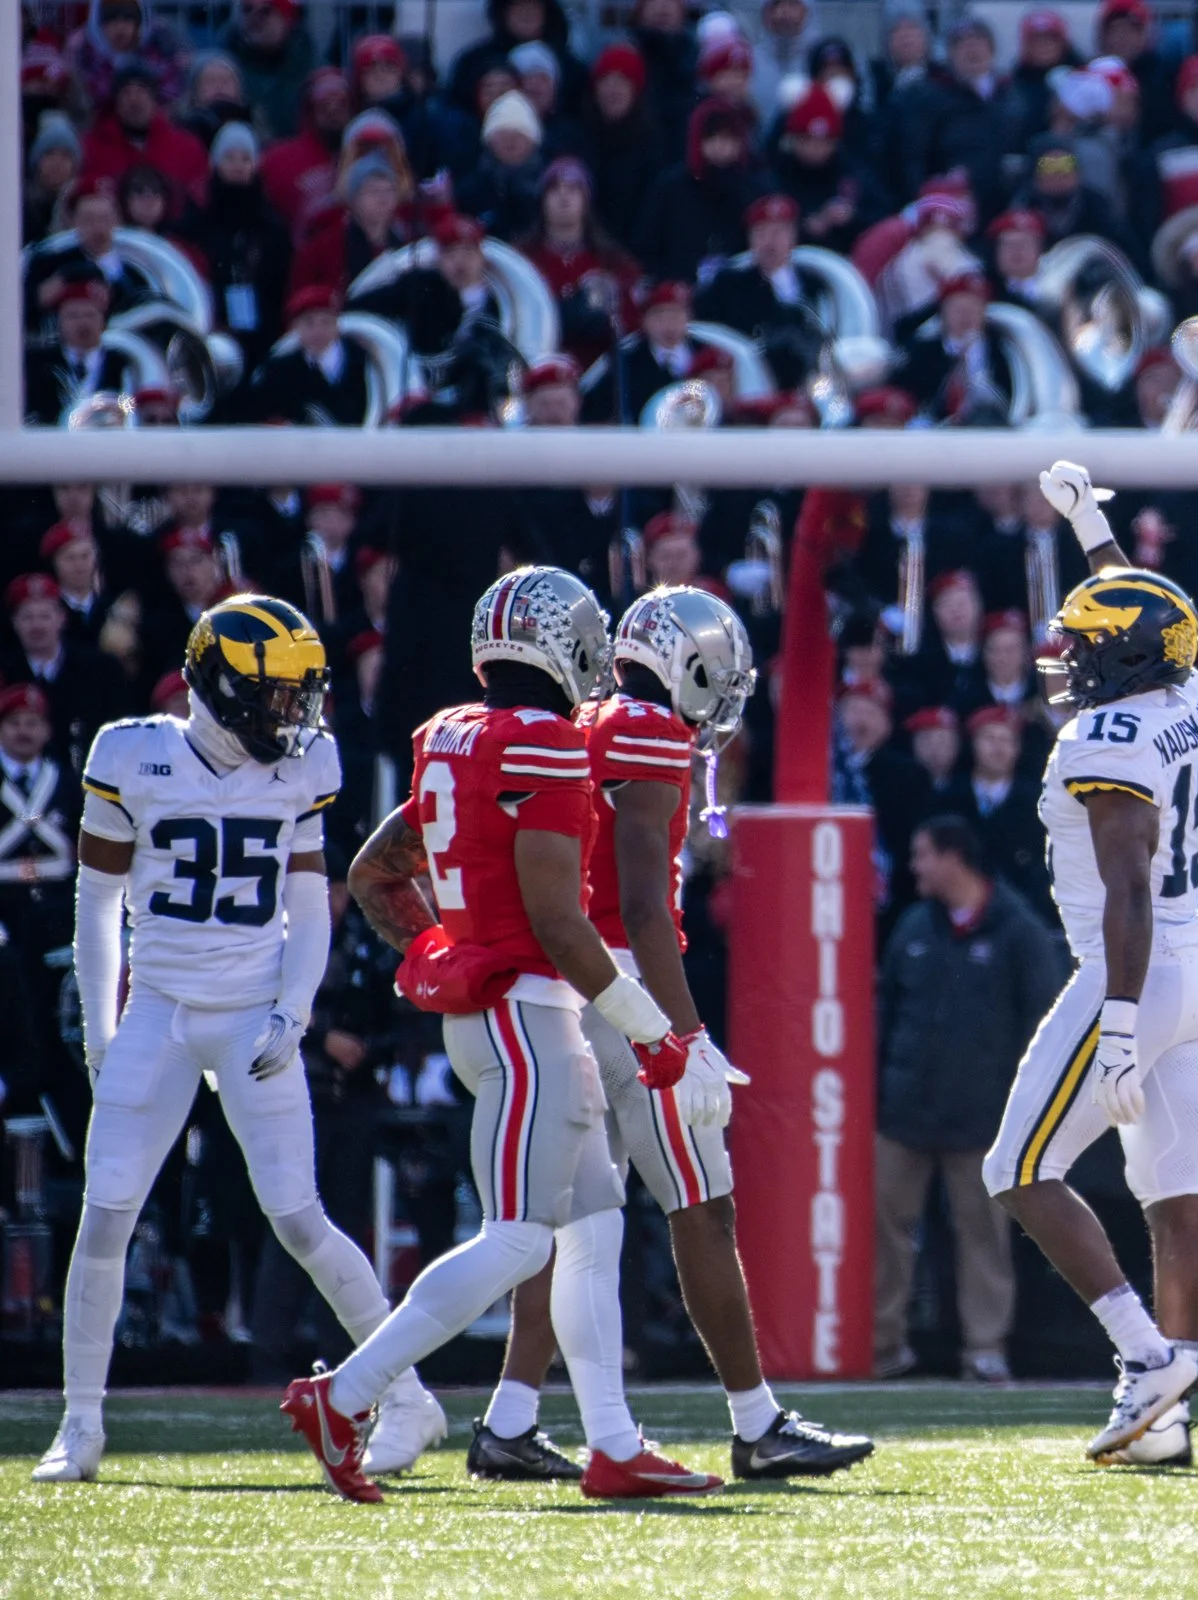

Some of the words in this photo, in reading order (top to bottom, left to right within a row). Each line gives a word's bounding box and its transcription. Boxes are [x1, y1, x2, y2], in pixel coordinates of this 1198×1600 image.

[1087, 712, 1141, 743] 15
[149, 817, 284, 927] 35
[420, 761, 466, 910] 2
[811, 821, 844, 1057] OHIO
[811, 1068, 845, 1373] STATE
